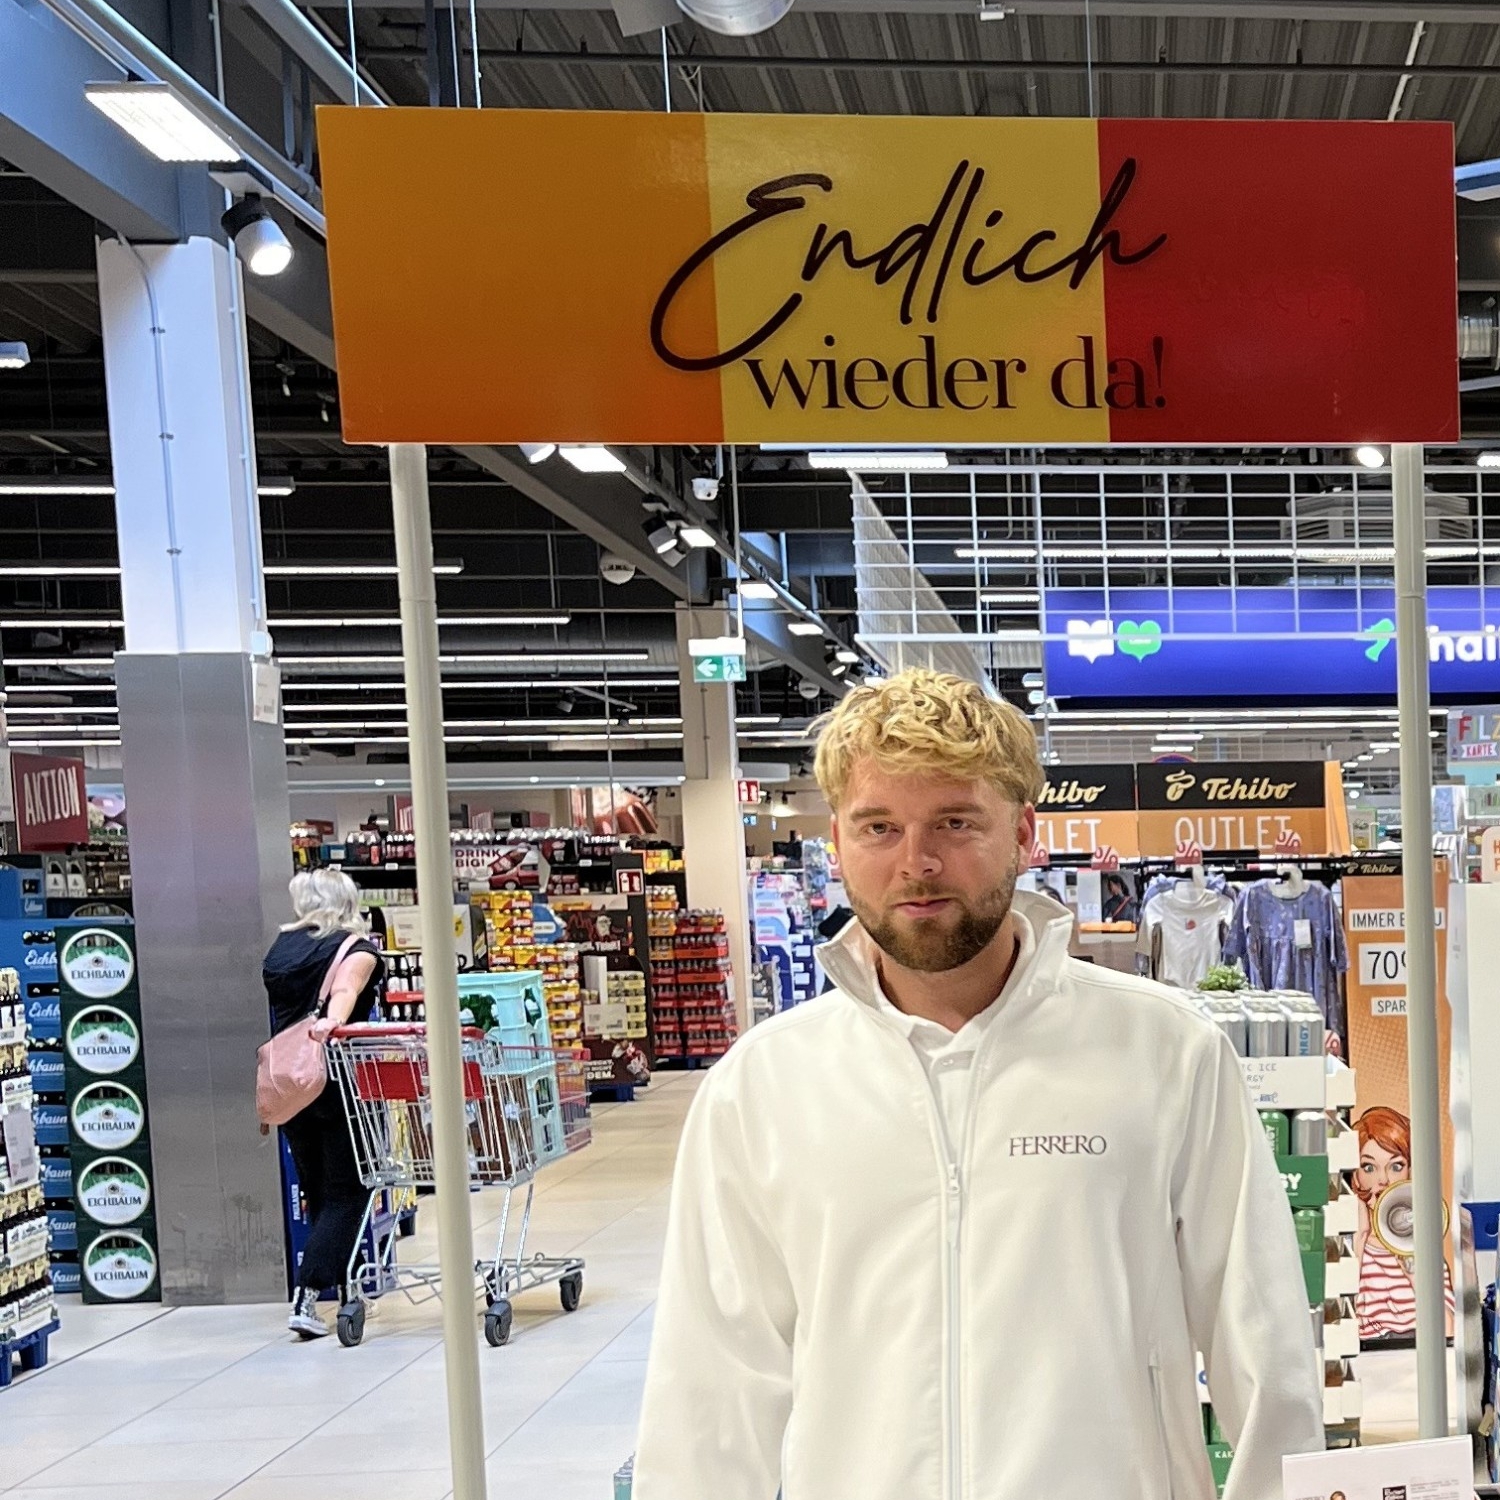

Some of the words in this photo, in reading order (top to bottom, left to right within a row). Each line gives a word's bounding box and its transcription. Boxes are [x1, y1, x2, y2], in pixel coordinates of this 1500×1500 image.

[649, 157, 1169, 373] Endlich
[742, 334, 1026, 411] wieder
[1049, 335, 1168, 410] da!
[1466, 745, 1493, 757] KARTE
[24, 766, 80, 826] AKTION
[1038, 781, 1106, 803] hibo
[1202, 778, 1297, 800] Tchibo
[1037, 819, 1101, 850] TLET
[1175, 816, 1291, 850] OUTLET
[455, 849, 502, 858] DRINK
[455, 858, 485, 868] BIG!
[1361, 864, 1397, 873] Tchibo
[1352, 912, 1395, 928] IMMER
[24, 949, 58, 966] Eichb
[1367, 950, 1407, 979] 70
[71, 969, 126, 980] EICHBAUM
[28, 1001, 60, 1018] Eichb
[1377, 1001, 1406, 1013] SPAR
[77, 1046, 131, 1056] EICHBAUM
[1246, 1074, 1264, 1082] RGY
[82, 1121, 136, 1132] EICHBAUM
[1009, 1135, 1107, 1156] FERRERO
[87, 1196, 142, 1207] EICHBAUM
[94, 1270, 149, 1282] EICHBAUM
